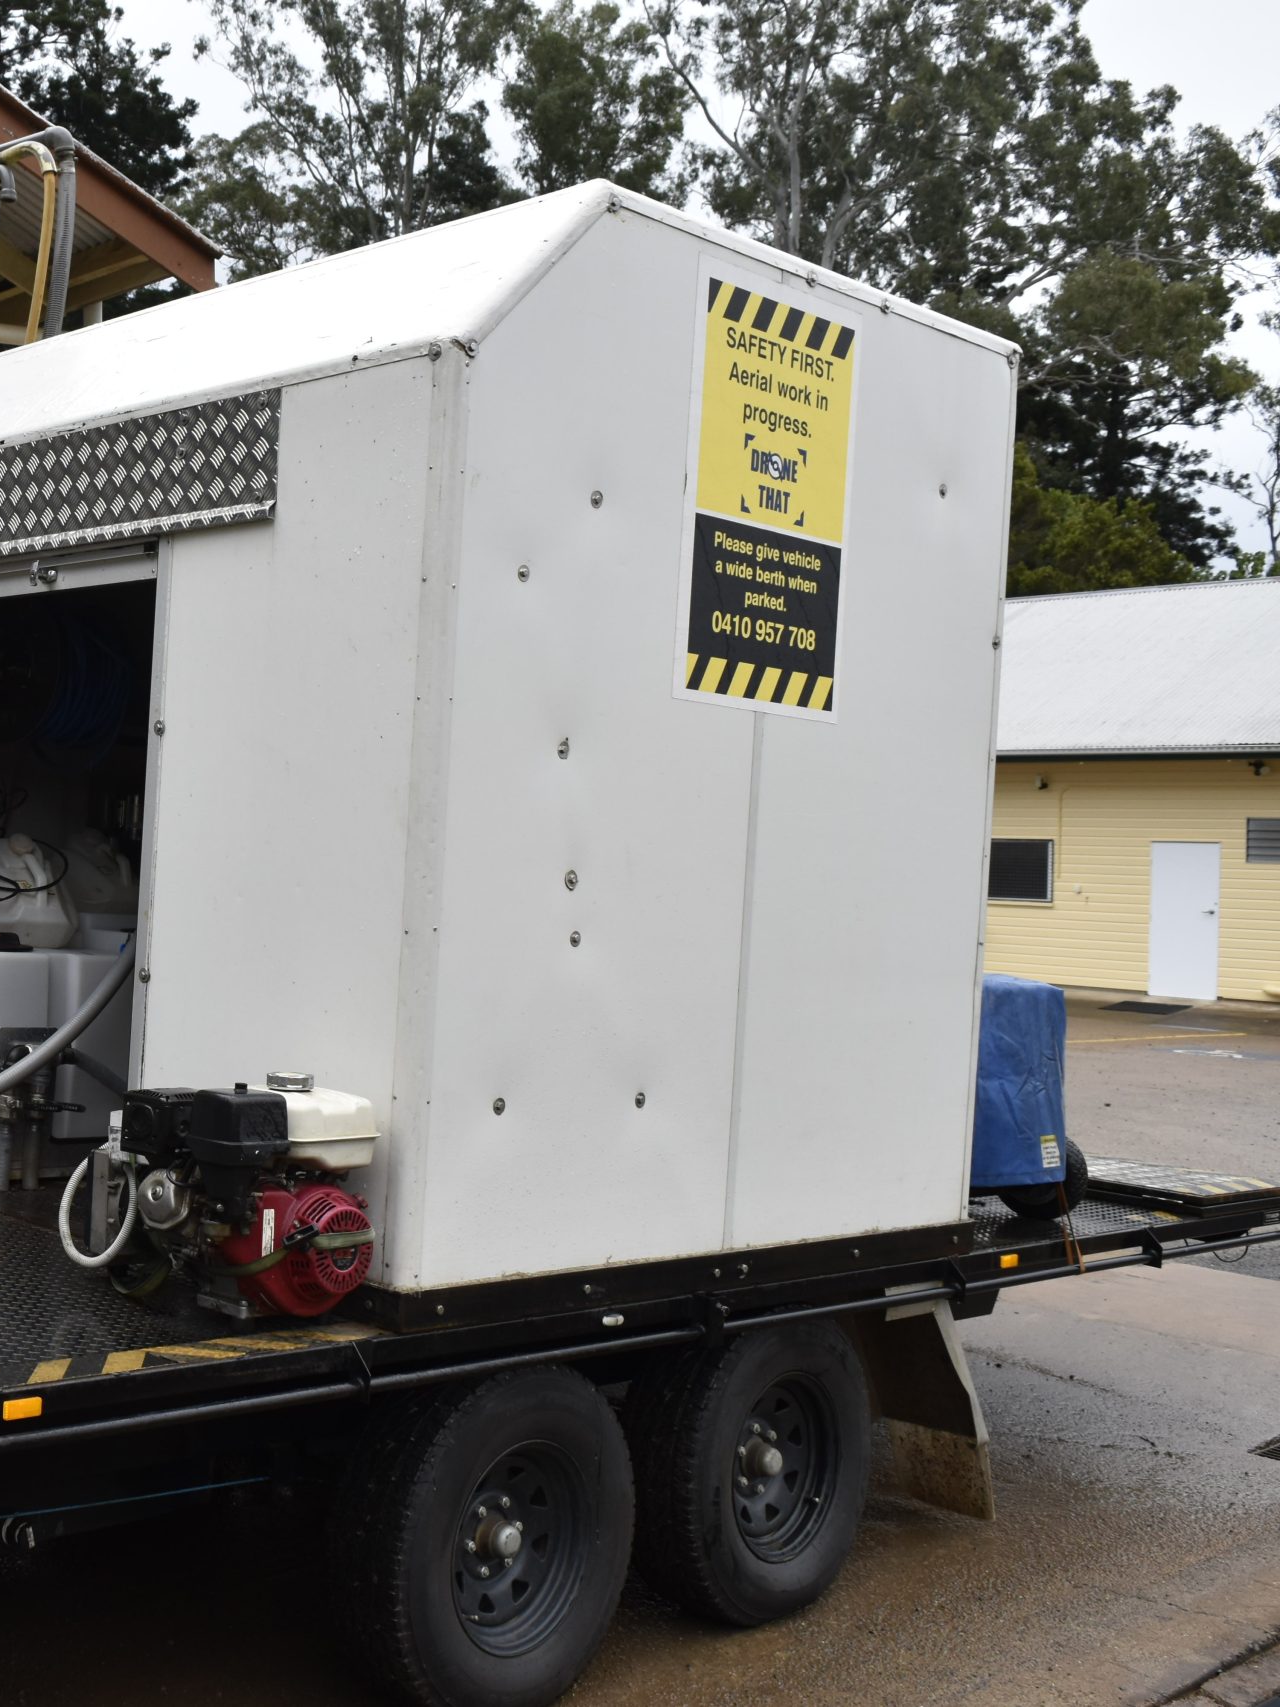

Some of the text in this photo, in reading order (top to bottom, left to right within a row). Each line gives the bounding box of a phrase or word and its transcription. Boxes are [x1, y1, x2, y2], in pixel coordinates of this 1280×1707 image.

[726, 326, 835, 382] SAFETY FIRST.
[729, 361, 829, 411] Aerial work in
[743, 402, 812, 438] progress.
[750, 448, 798, 484] DRONE
[758, 484, 791, 514] THAT
[714, 530, 821, 571] Please give vehicle
[715, 560, 817, 594] a wide berth when
[744, 590, 787, 612] parked.
[712, 610, 816, 651] 0410 957 708
